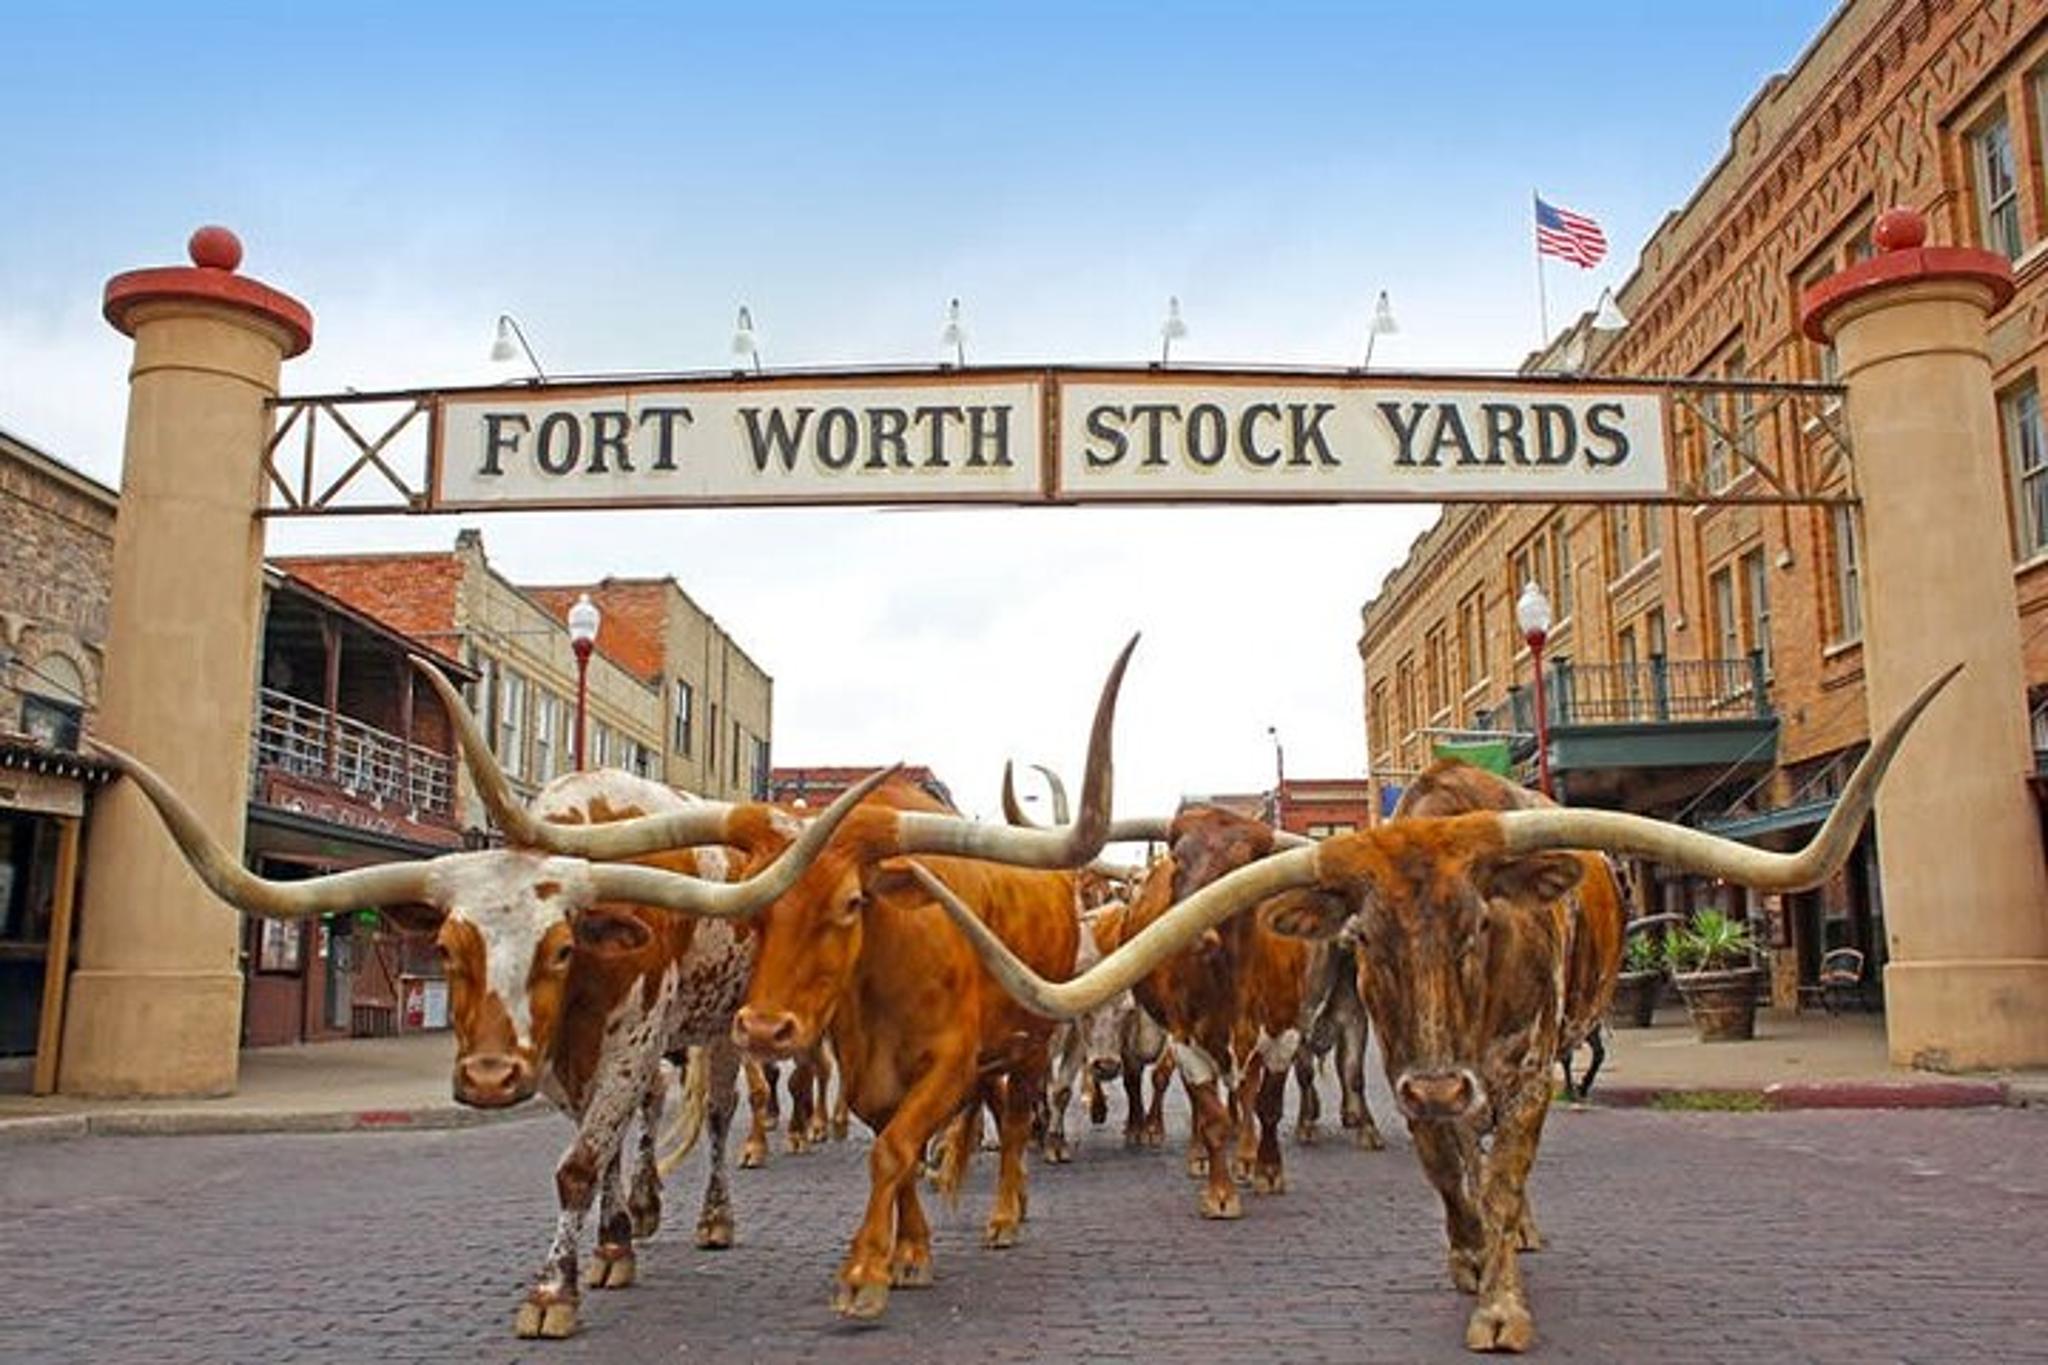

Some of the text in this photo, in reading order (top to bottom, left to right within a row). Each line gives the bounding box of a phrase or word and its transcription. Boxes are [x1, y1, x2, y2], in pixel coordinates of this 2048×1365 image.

[478, 403, 1628, 475] FORT WORTH STOCK YARDS
